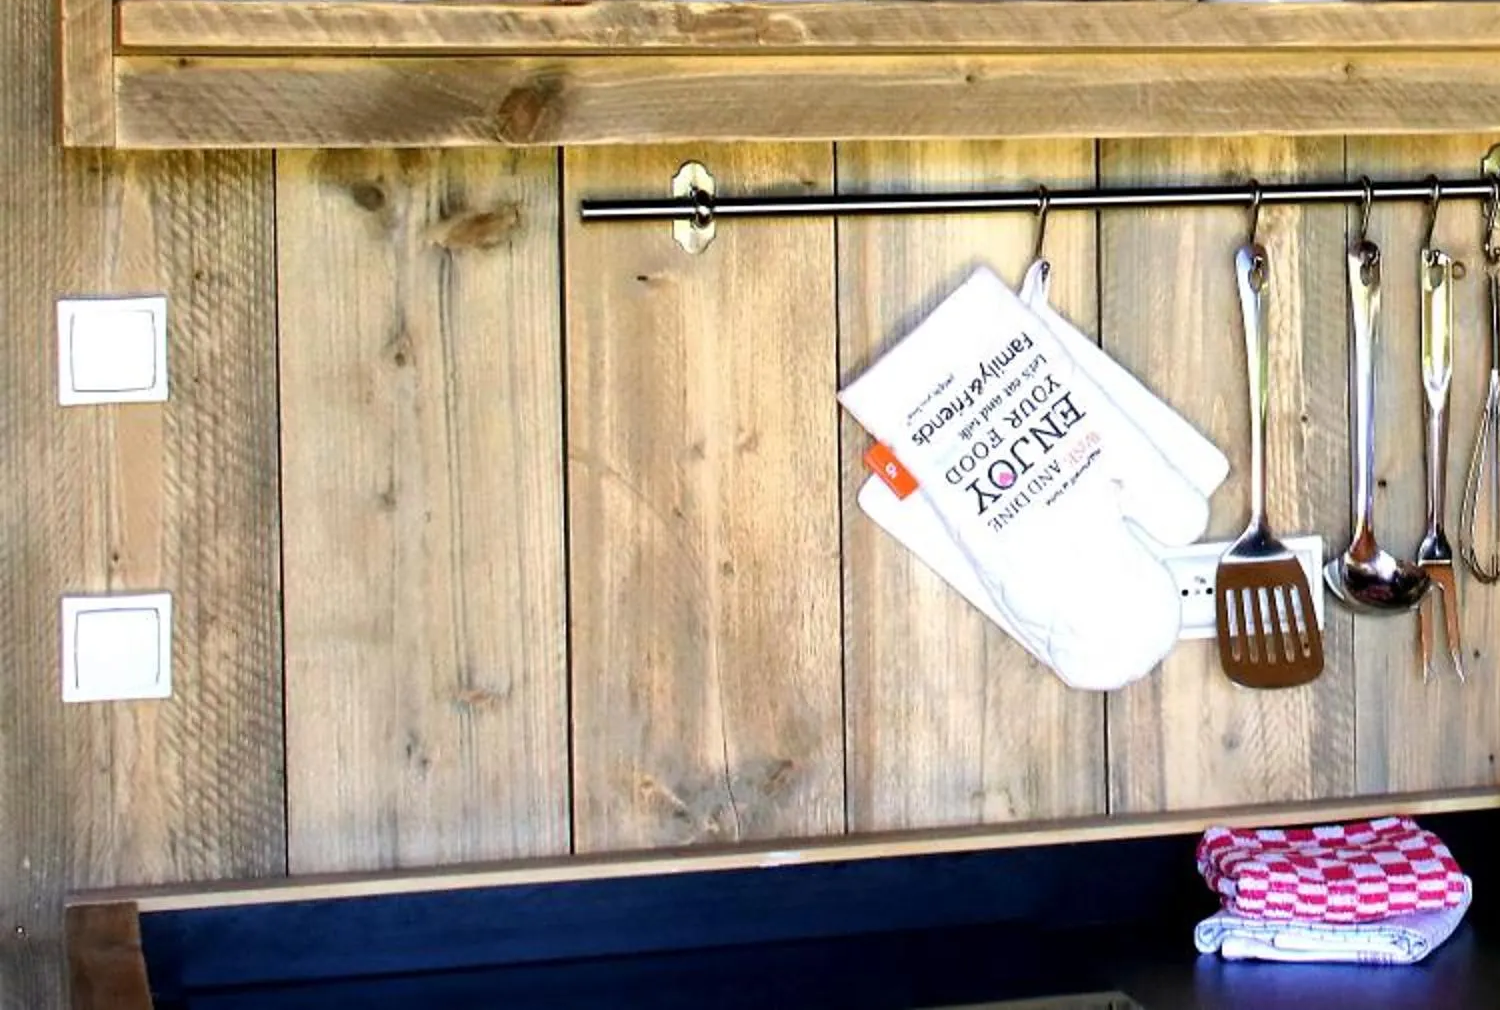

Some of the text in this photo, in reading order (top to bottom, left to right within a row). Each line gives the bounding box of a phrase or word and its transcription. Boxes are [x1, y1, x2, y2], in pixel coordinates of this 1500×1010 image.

[1002, 373, 1062, 429] YOUR
[1003, 377, 1022, 397] eat
[978, 394, 1003, 422] and
[945, 427, 1005, 485] FOOD
[964, 391, 1087, 516] ENJOY
[1027, 459, 1061, 495] AND
[987, 491, 1031, 532] DINE
